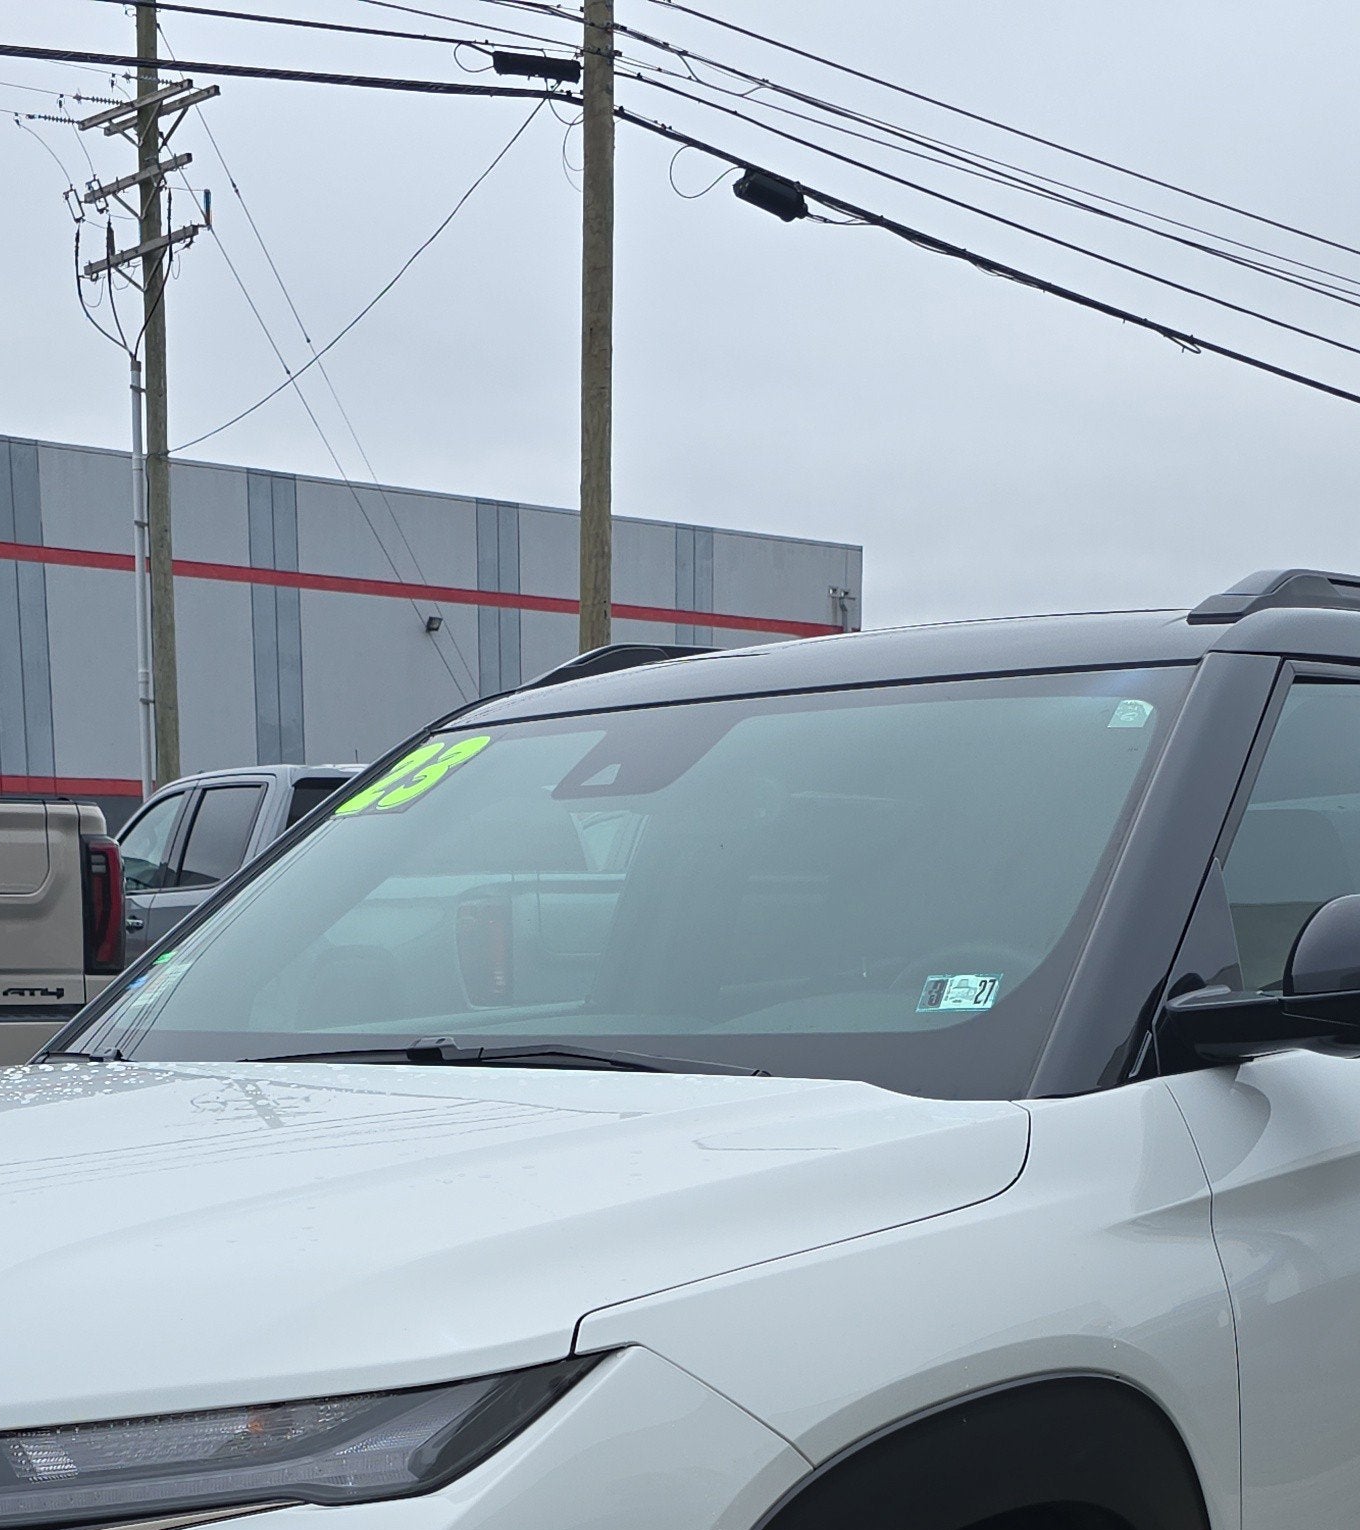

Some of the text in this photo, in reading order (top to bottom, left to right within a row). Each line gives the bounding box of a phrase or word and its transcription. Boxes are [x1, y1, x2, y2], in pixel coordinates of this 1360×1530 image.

[335, 736, 491, 812] 23
[2, 988, 65, 1000] AT4
[973, 979, 997, 1005] 27
